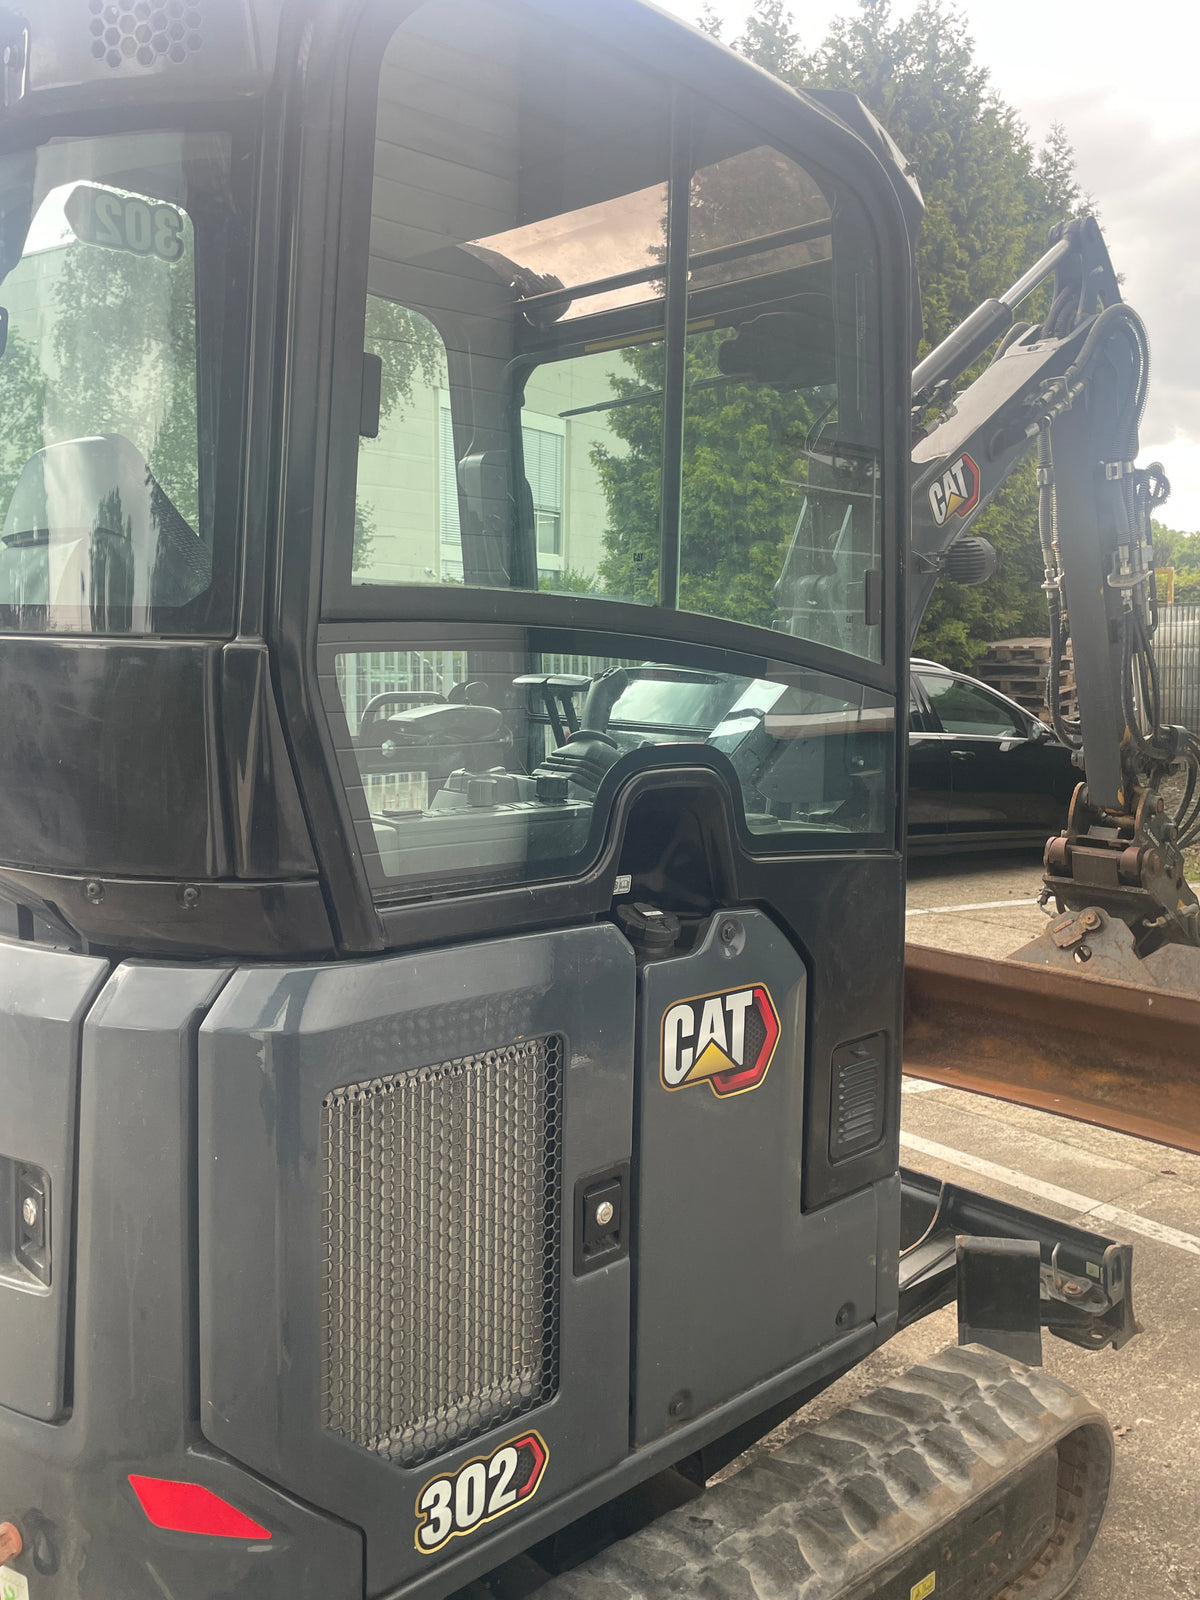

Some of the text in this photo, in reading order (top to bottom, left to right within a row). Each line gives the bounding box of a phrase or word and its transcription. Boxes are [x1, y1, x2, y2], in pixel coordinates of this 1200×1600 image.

[929, 458, 968, 524] CAT
[664, 990, 753, 1085] CAT
[421, 1447, 518, 1545] 302
